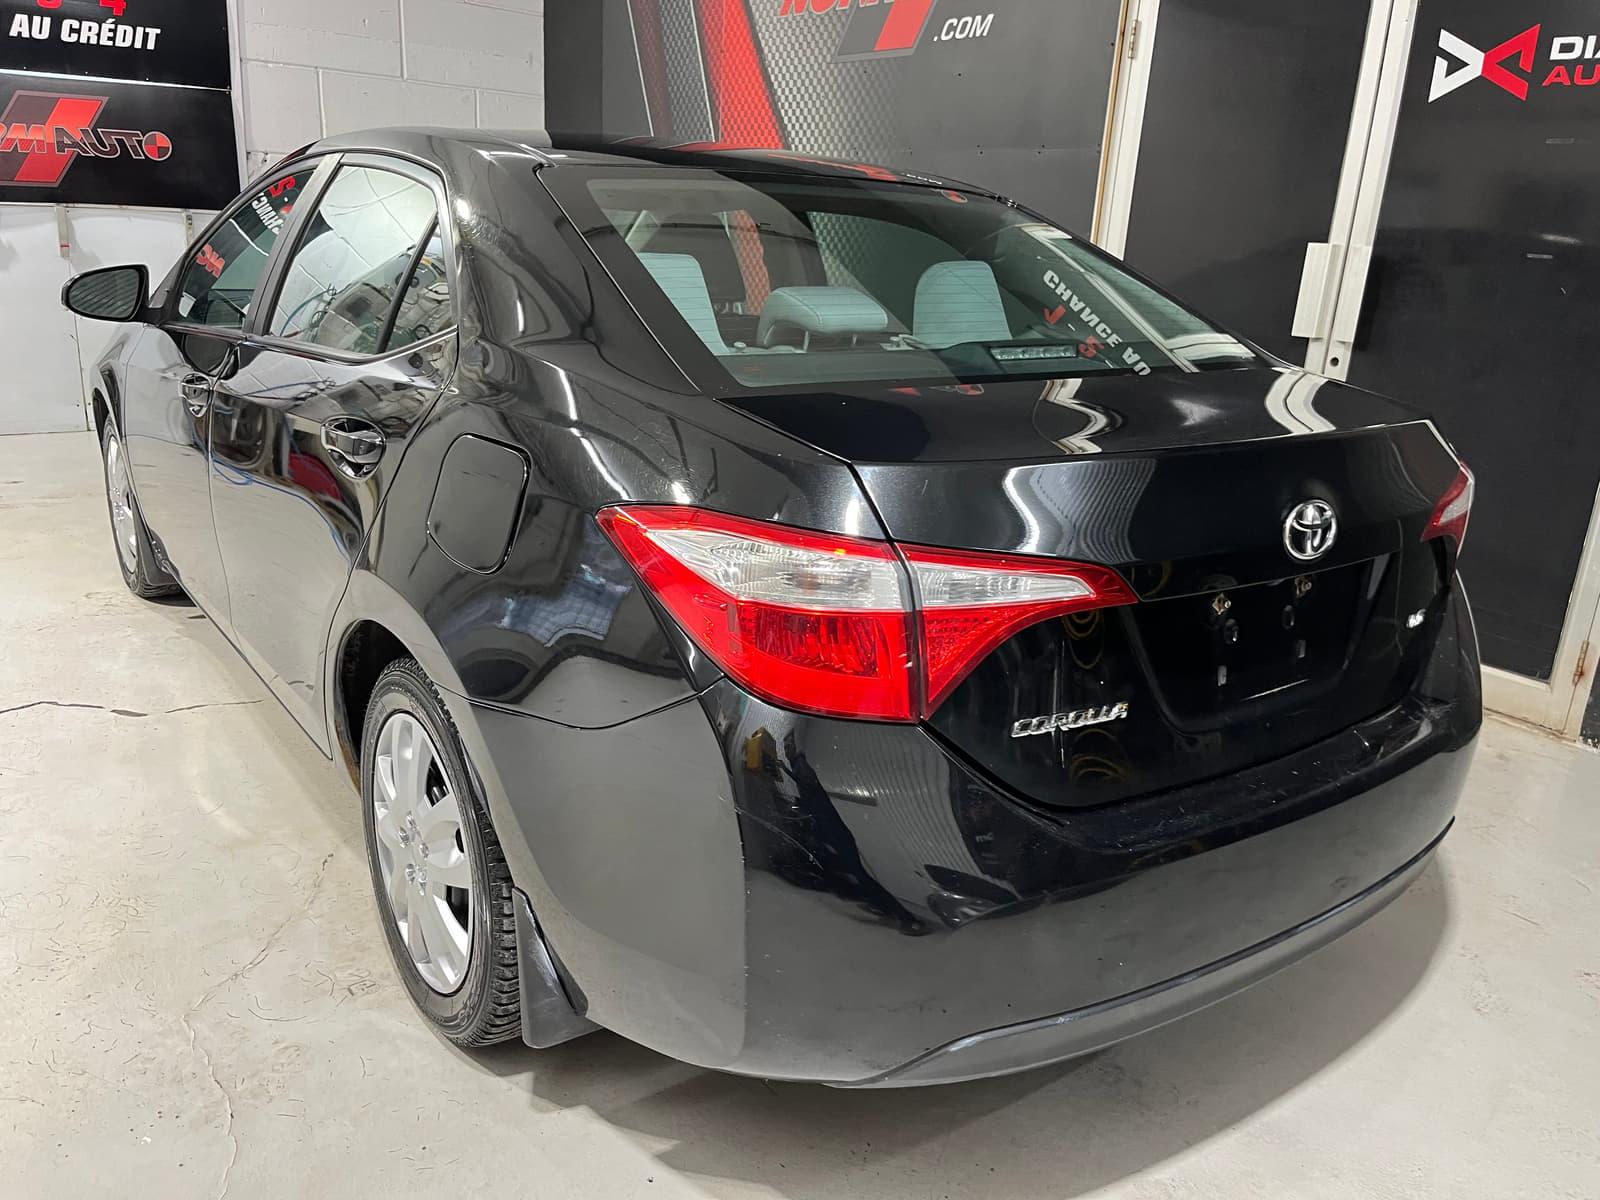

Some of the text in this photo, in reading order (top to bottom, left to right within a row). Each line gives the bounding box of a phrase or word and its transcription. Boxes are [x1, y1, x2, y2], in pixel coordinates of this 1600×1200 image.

[9, 13, 161, 50] AU CRÉDIT
[933, 13, 995, 42] .COM
[0, 123, 173, 161] MAUTO
[1011, 702, 1129, 738] COROLLA
